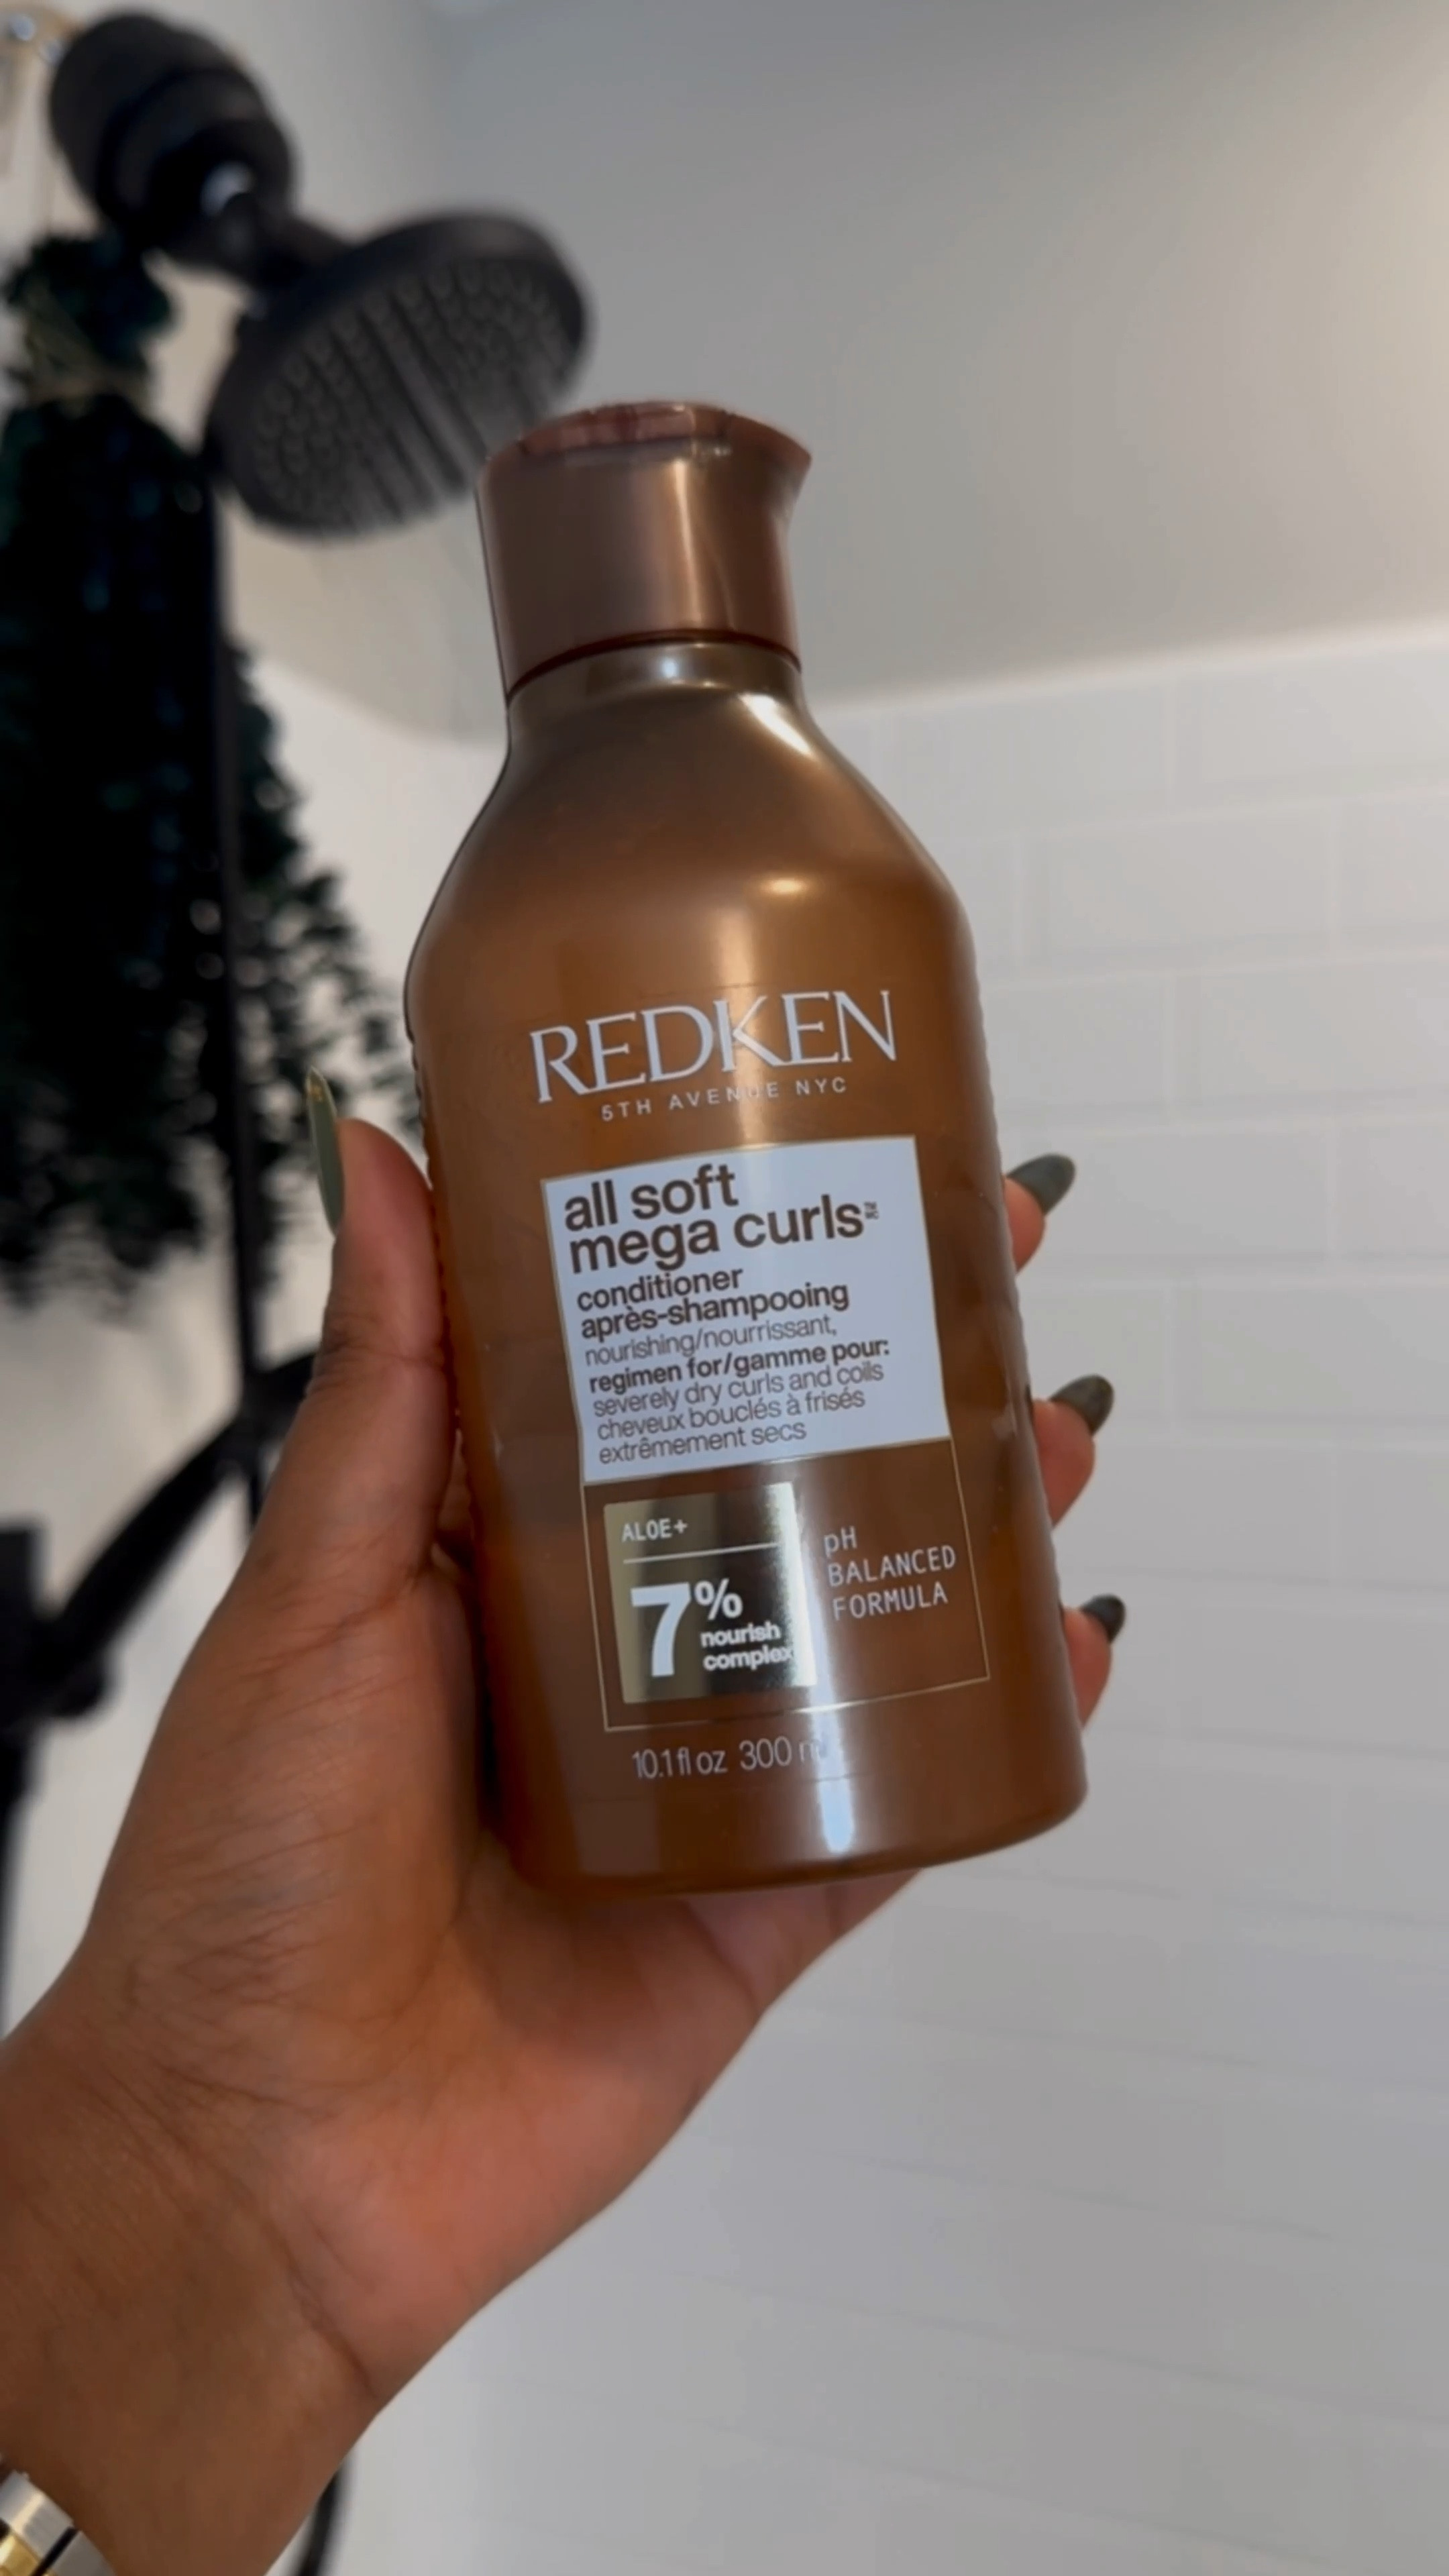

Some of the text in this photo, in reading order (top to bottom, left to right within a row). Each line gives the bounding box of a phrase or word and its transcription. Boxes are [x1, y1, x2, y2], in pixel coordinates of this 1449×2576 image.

[530, 990, 896, 1103] REDKEN
[601, 1077, 847, 1121] 5TH AVENUE NYC
[564, 1163, 739, 1232] all soft
[570, 1193, 864, 1273] mega curls
[577, 1268, 743, 1311] conditioner
[581, 1281, 850, 1342] après-shampooing
[585, 1313, 837, 1366] nourishing/nourrissant,
[589, 1363, 682, 1394] regimen
[687, 1344, 826, 1379] for/gamme
[594, 1360, 884, 1417] severely dry curls and coils
[598, 1387, 865, 1440] cheveux bouclés à frisés
[599, 1420, 807, 1464] extrêmement secs
[622, 1517, 688, 1543] ALOE+
[823, 1526, 859, 1557] pH
[826, 1544, 957, 1587] BALANCED
[832, 1580, 949, 1621] FORMULA
[700, 1619, 782, 1648] nourish
[703, 1644, 794, 1671] complex
[632, 1748, 674, 1779] 10.1
[676, 1746, 692, 1776] fl
[696, 1750, 729, 1775] oz
[739, 1735, 793, 1771] 300
